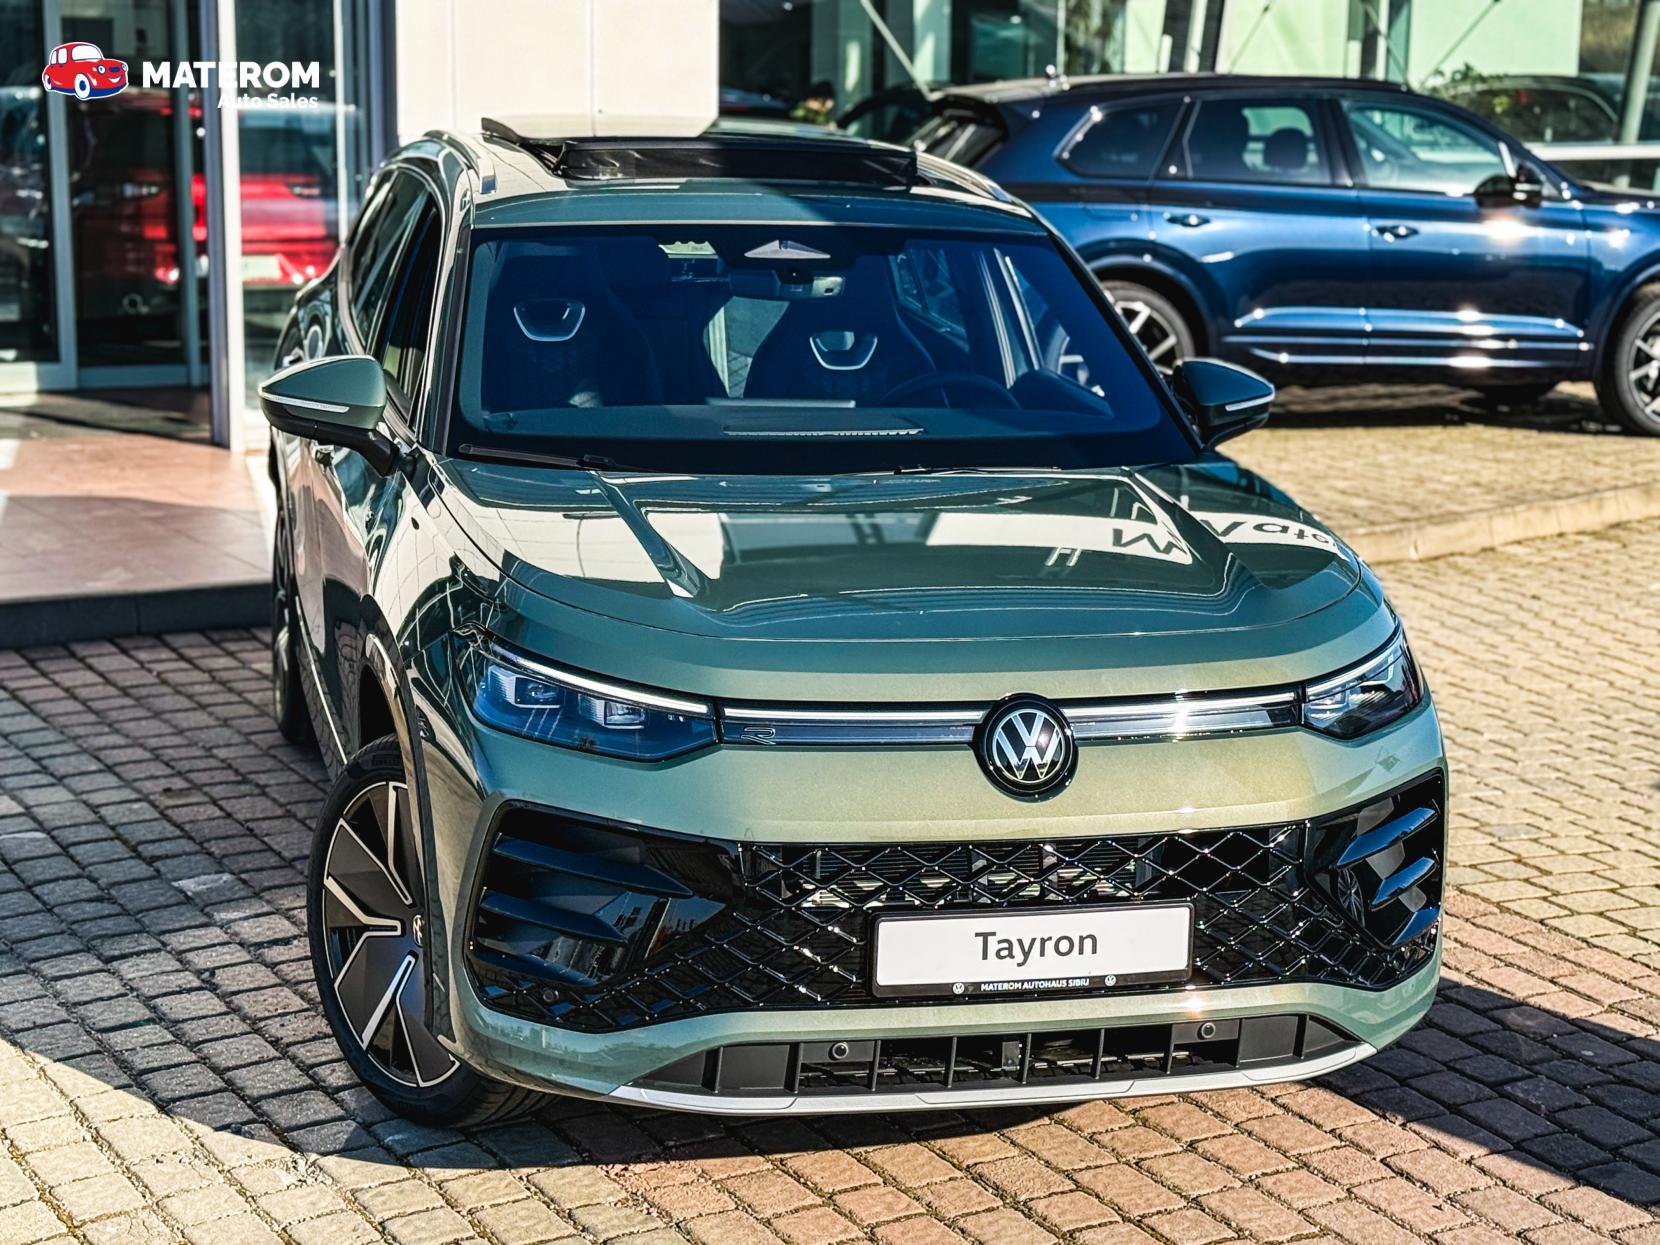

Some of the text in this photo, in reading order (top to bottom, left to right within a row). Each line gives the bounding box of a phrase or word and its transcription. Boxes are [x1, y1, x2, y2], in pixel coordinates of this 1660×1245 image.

[974, 930, 1098, 967] Tayron
[980, 983, 1022, 993] MATEROM
[1022, 980, 1067, 991] AUTOHAUS
[1068, 978, 1090, 988] SIBIU
